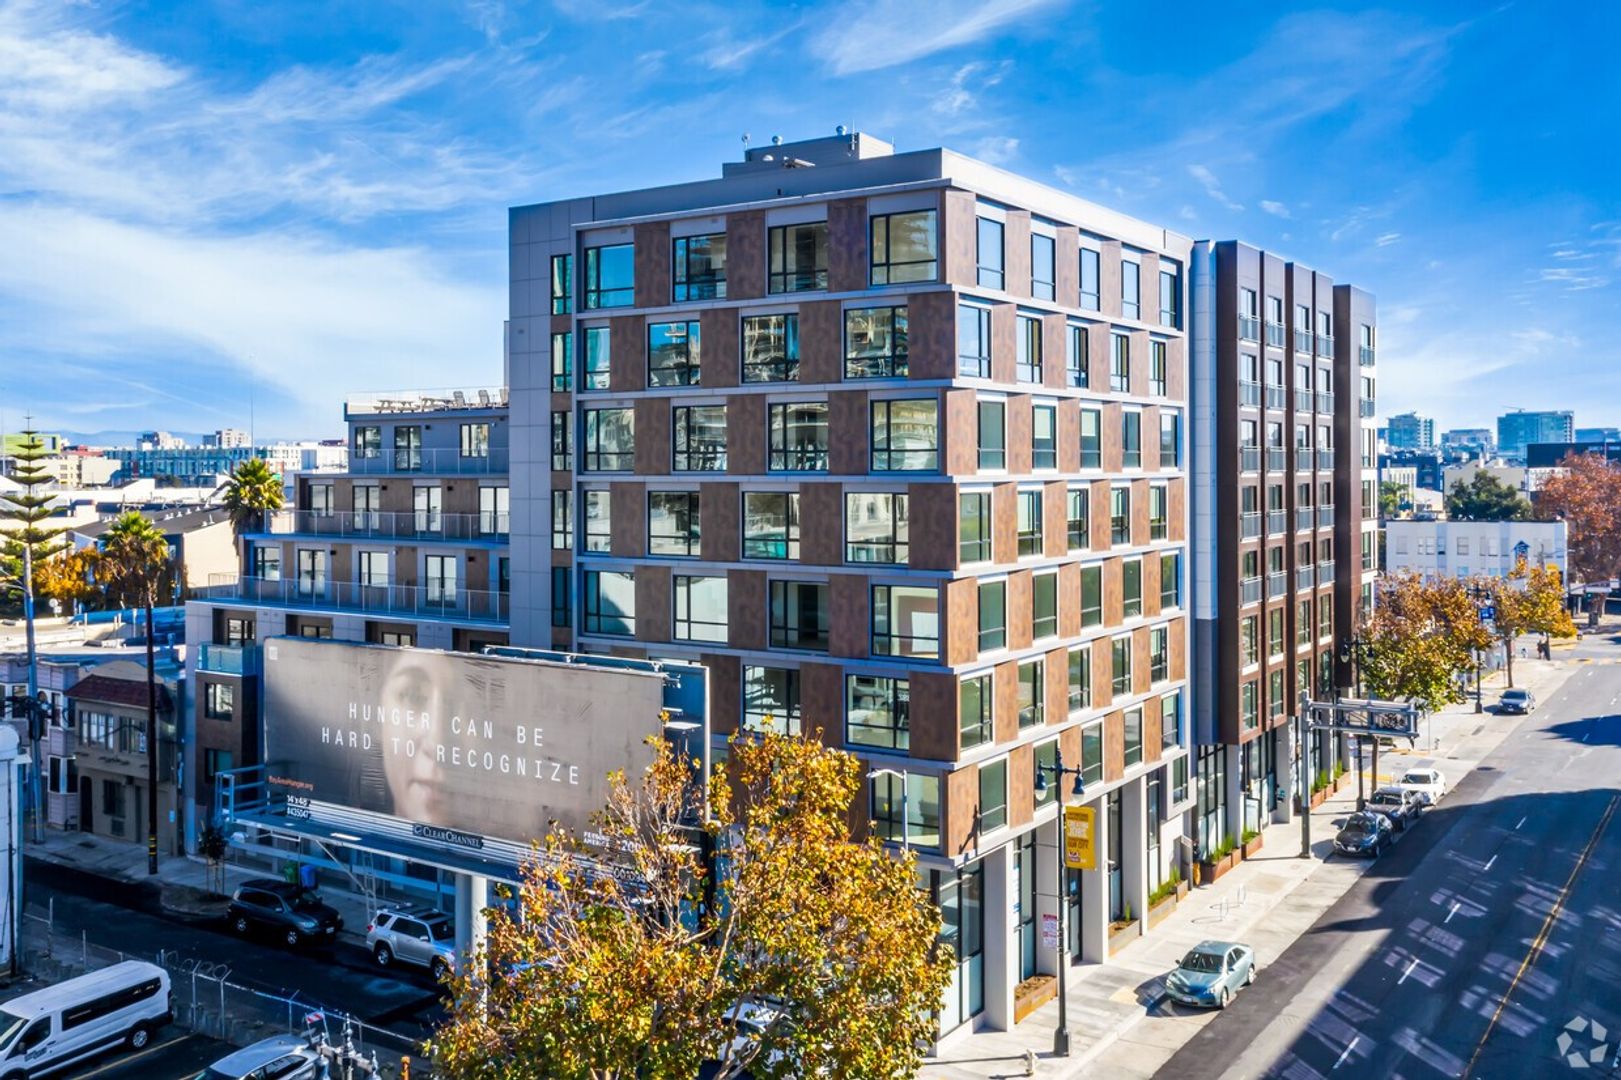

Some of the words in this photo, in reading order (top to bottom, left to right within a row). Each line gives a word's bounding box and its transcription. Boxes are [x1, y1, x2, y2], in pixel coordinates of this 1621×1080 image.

[348, 702, 431, 730] HUNGER
[451, 716, 493, 740] CAN
[516, 725, 544, 747] BE
[321, 727, 372, 750] HARD
[391, 737, 416, 758] TO
[436, 744, 579, 785] RECOGNIZE
